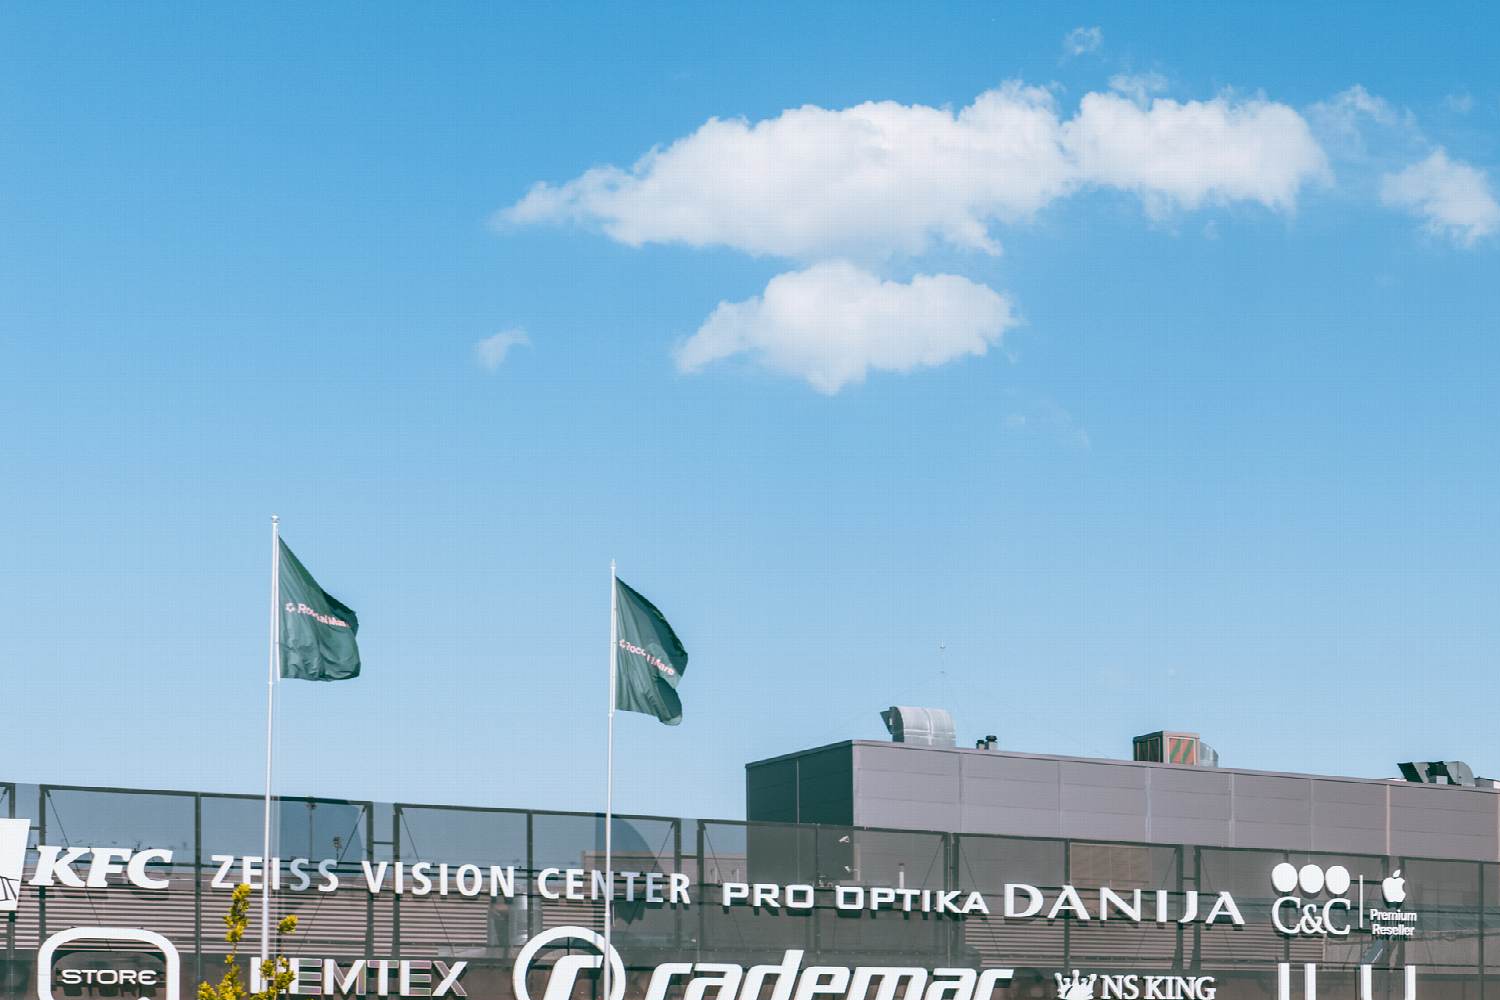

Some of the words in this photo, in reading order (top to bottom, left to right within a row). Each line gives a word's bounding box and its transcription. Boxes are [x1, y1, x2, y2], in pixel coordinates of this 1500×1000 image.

[30, 845, 174, 890] KFC
[211, 854, 339, 893] ZEISS
[361, 860, 516, 899] VISION
[537, 867, 691, 905] CENTER
[722, 882, 814, 909] PRO
[836, 885, 991, 915] OPTIKA
[1003, 882, 1246, 926] DANIJA
[1271, 895, 1351, 936] C&C
[1370, 908, 1418, 923] Premium
[1371, 923, 1416, 937] Reseller
[61, 968, 157, 987] STORE
[1101, 974, 1138, 1000] NS
